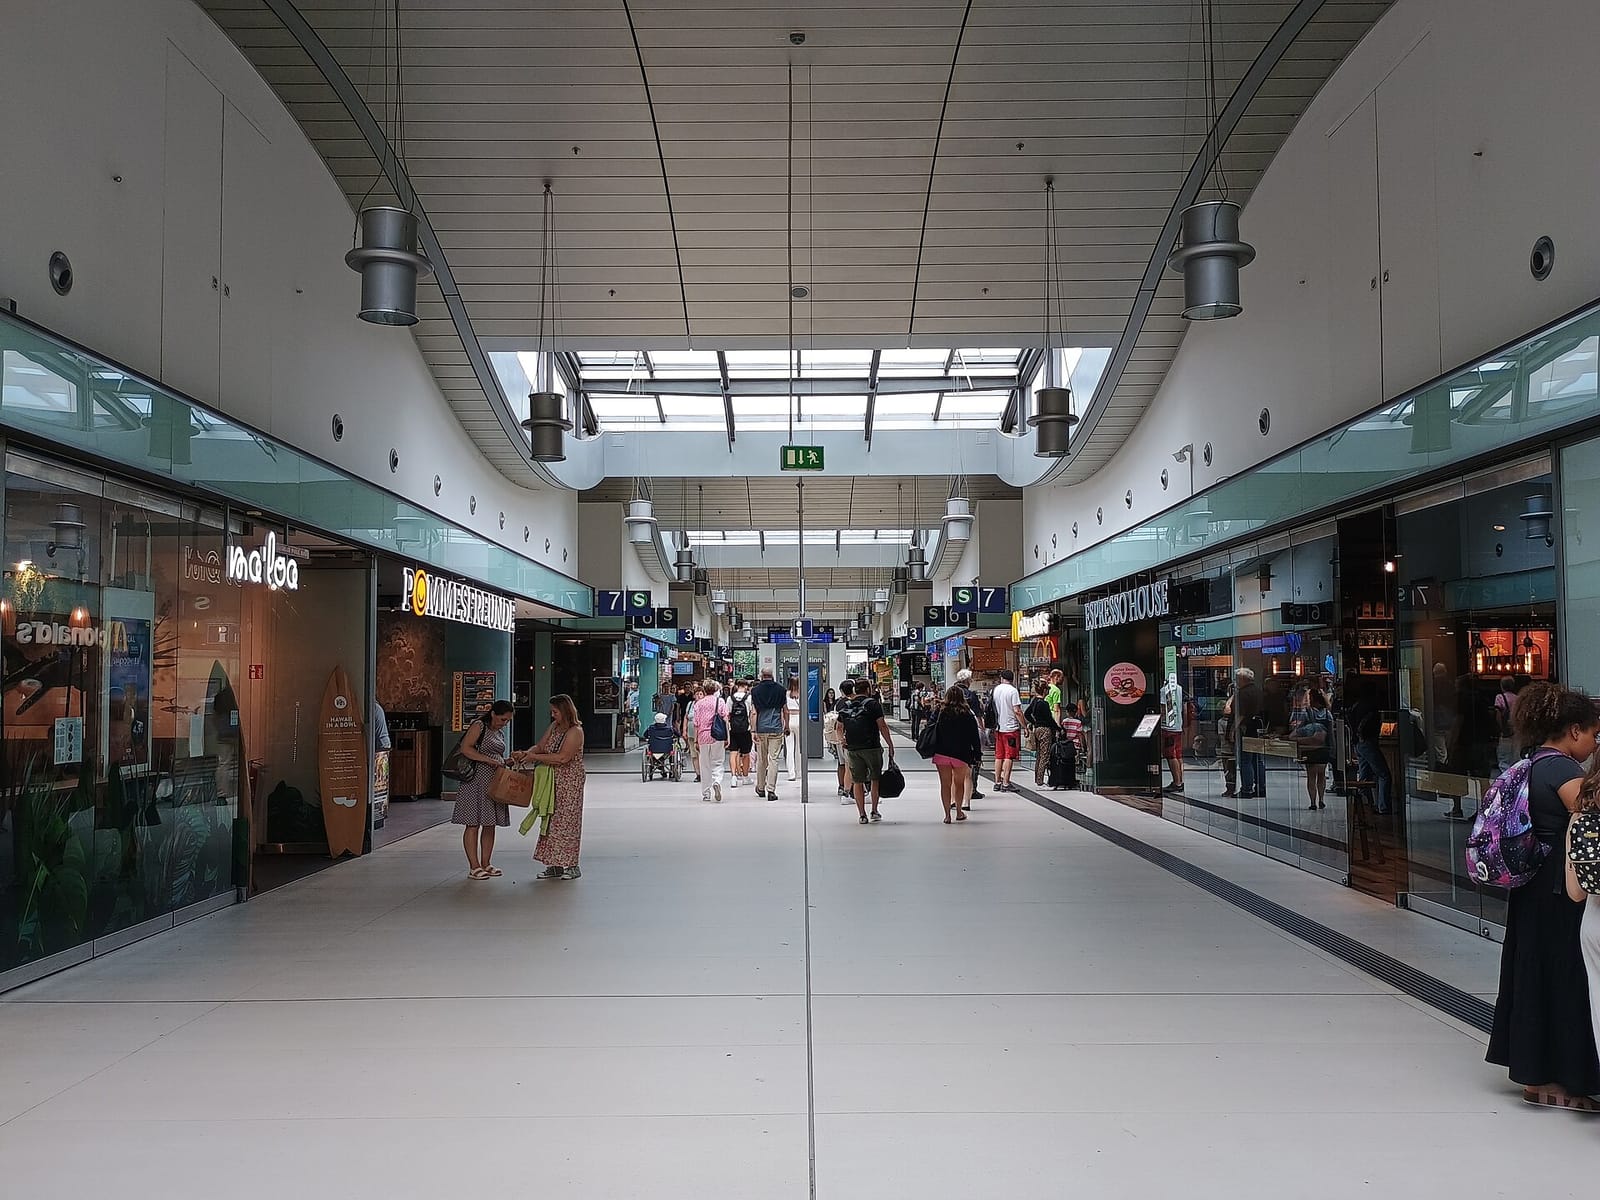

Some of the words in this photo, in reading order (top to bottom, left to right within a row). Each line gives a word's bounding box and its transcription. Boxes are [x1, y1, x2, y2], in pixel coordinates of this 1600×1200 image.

[402, 567, 516, 633] POMMESFREUNDE
[608, 591, 621, 611] 7
[633, 592, 646, 607] S
[957, 589, 970, 603] S
[982, 588, 995, 608] 7
[1084, 592, 1127, 631] ESPRESSO
[1127, 579, 1170, 622] HOUSE
[663, 609, 673, 621] S
[928, 608, 939, 620] S
[684, 629, 693, 642] 3
[909, 628, 918, 640] 3
[721, 646, 728, 655] 2
[874, 646, 880, 654] 2
[783, 656, 823, 664] Infortion
